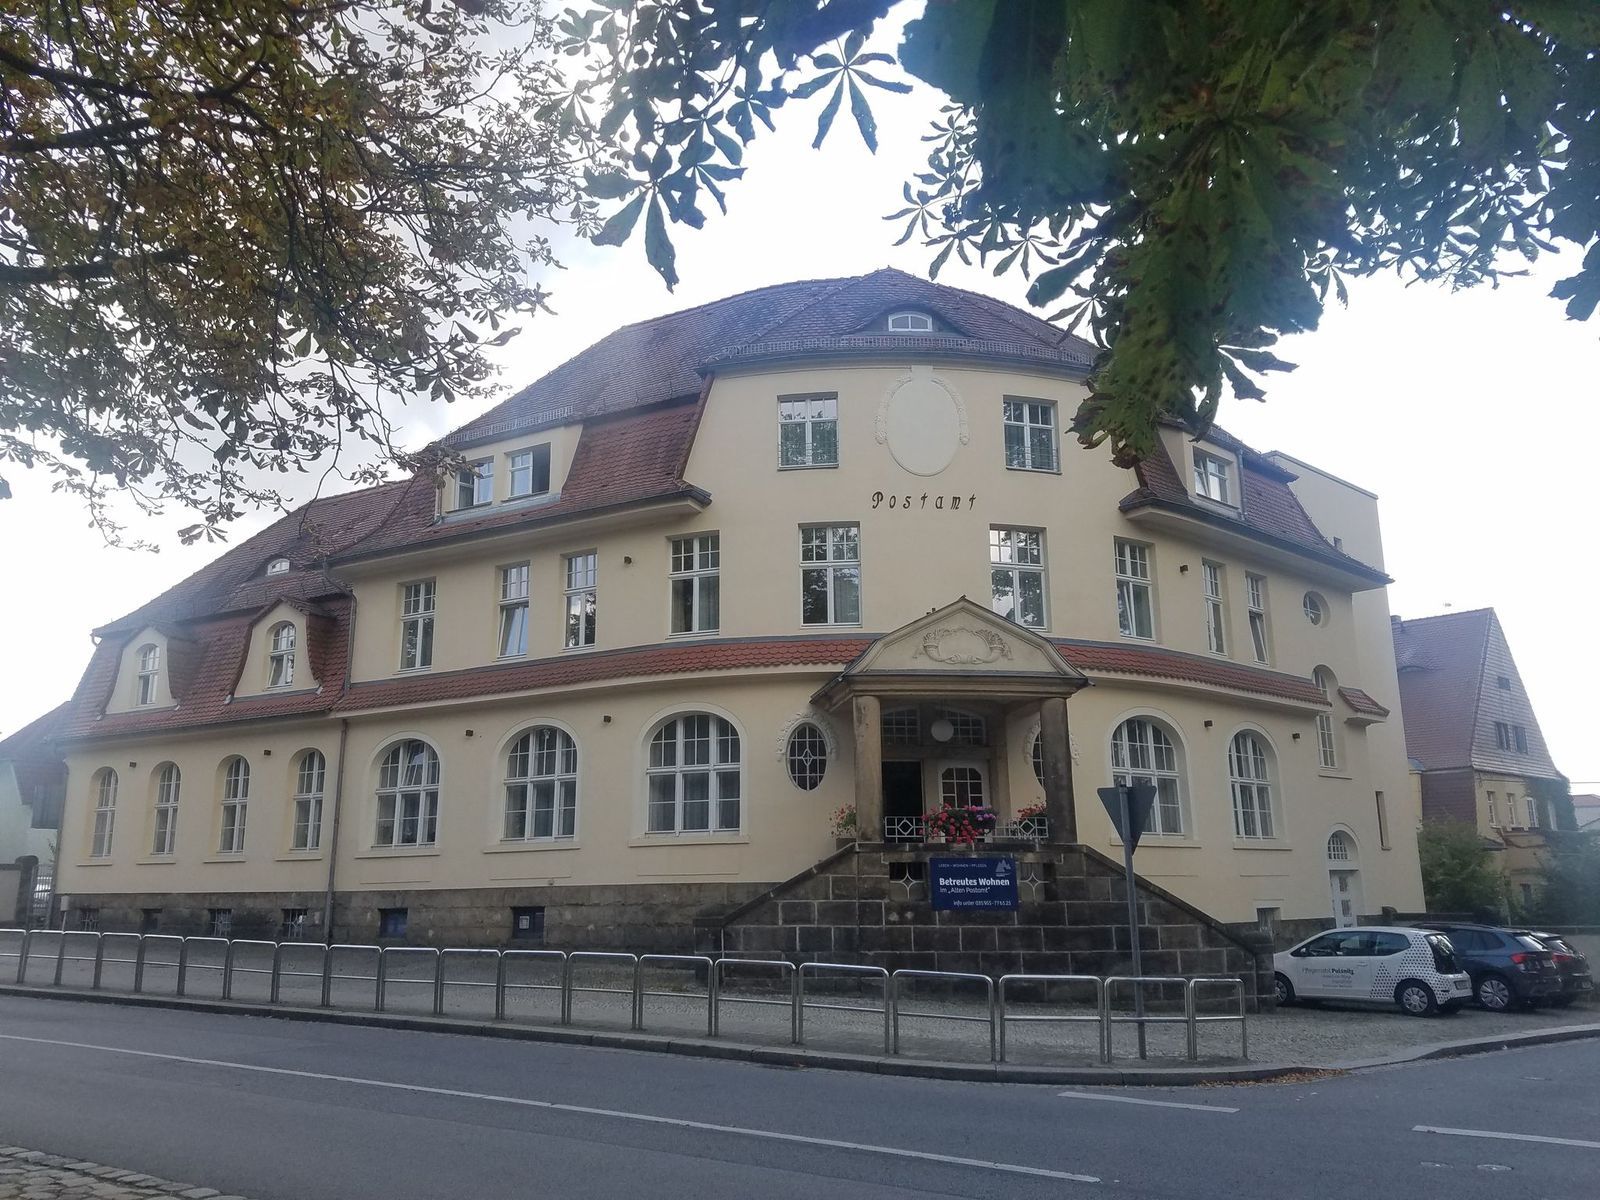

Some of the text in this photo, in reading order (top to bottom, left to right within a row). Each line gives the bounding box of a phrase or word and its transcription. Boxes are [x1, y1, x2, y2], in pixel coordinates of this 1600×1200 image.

[871, 491, 977, 511] Postamt
[939, 877, 1010, 886] Betreutes Wohnen
